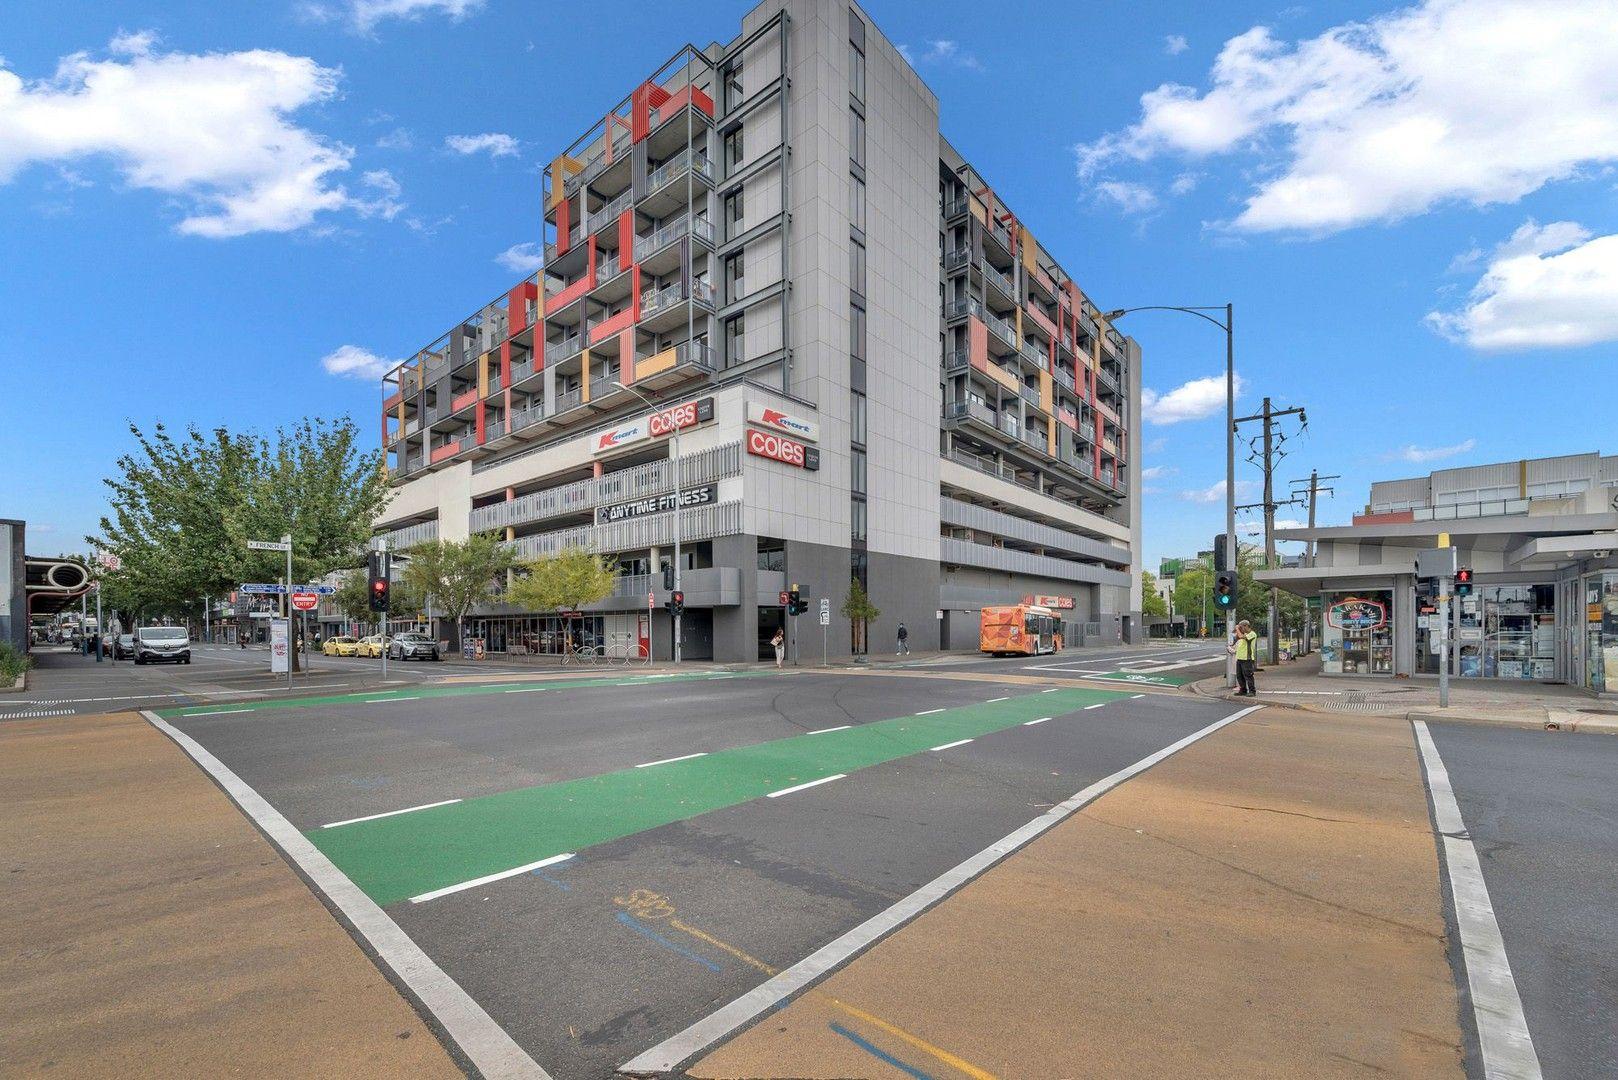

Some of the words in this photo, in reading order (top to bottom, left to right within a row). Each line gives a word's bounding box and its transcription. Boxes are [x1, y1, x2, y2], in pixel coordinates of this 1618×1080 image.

[651, 404, 696, 434] coles
[762, 408, 810, 433] Kmart
[599, 428, 639, 449] Kmart
[751, 433, 804, 464] coles
[610, 498, 656, 519] ANYTIME
[660, 487, 709, 510] FITNESS
